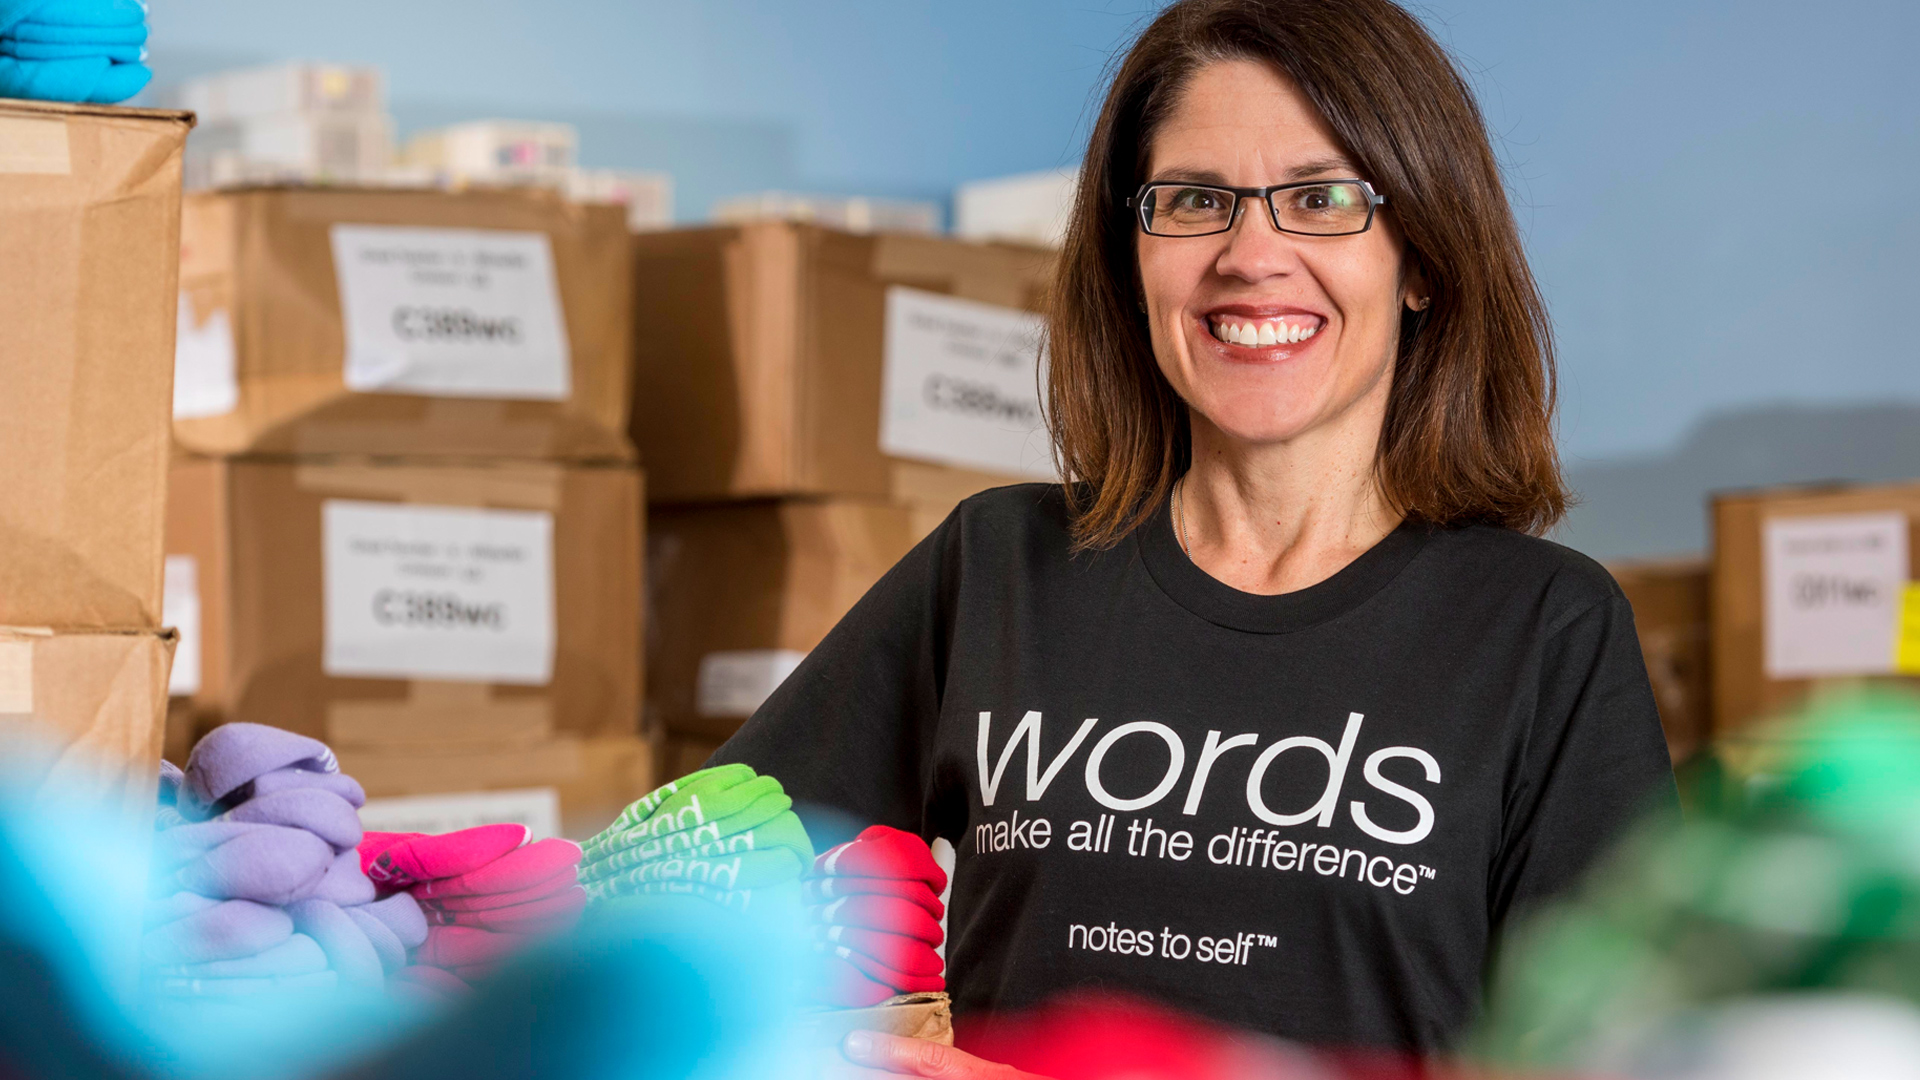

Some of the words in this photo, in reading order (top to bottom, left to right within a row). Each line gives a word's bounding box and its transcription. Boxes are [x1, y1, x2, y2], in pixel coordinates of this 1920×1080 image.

[977, 710, 1441, 845] words
[976, 810, 1051, 854] make
[1067, 814, 1115, 854] all
[1128, 819, 1193, 861] the
[1069, 922, 1154, 957] notes
[1160, 927, 1191, 960] to
